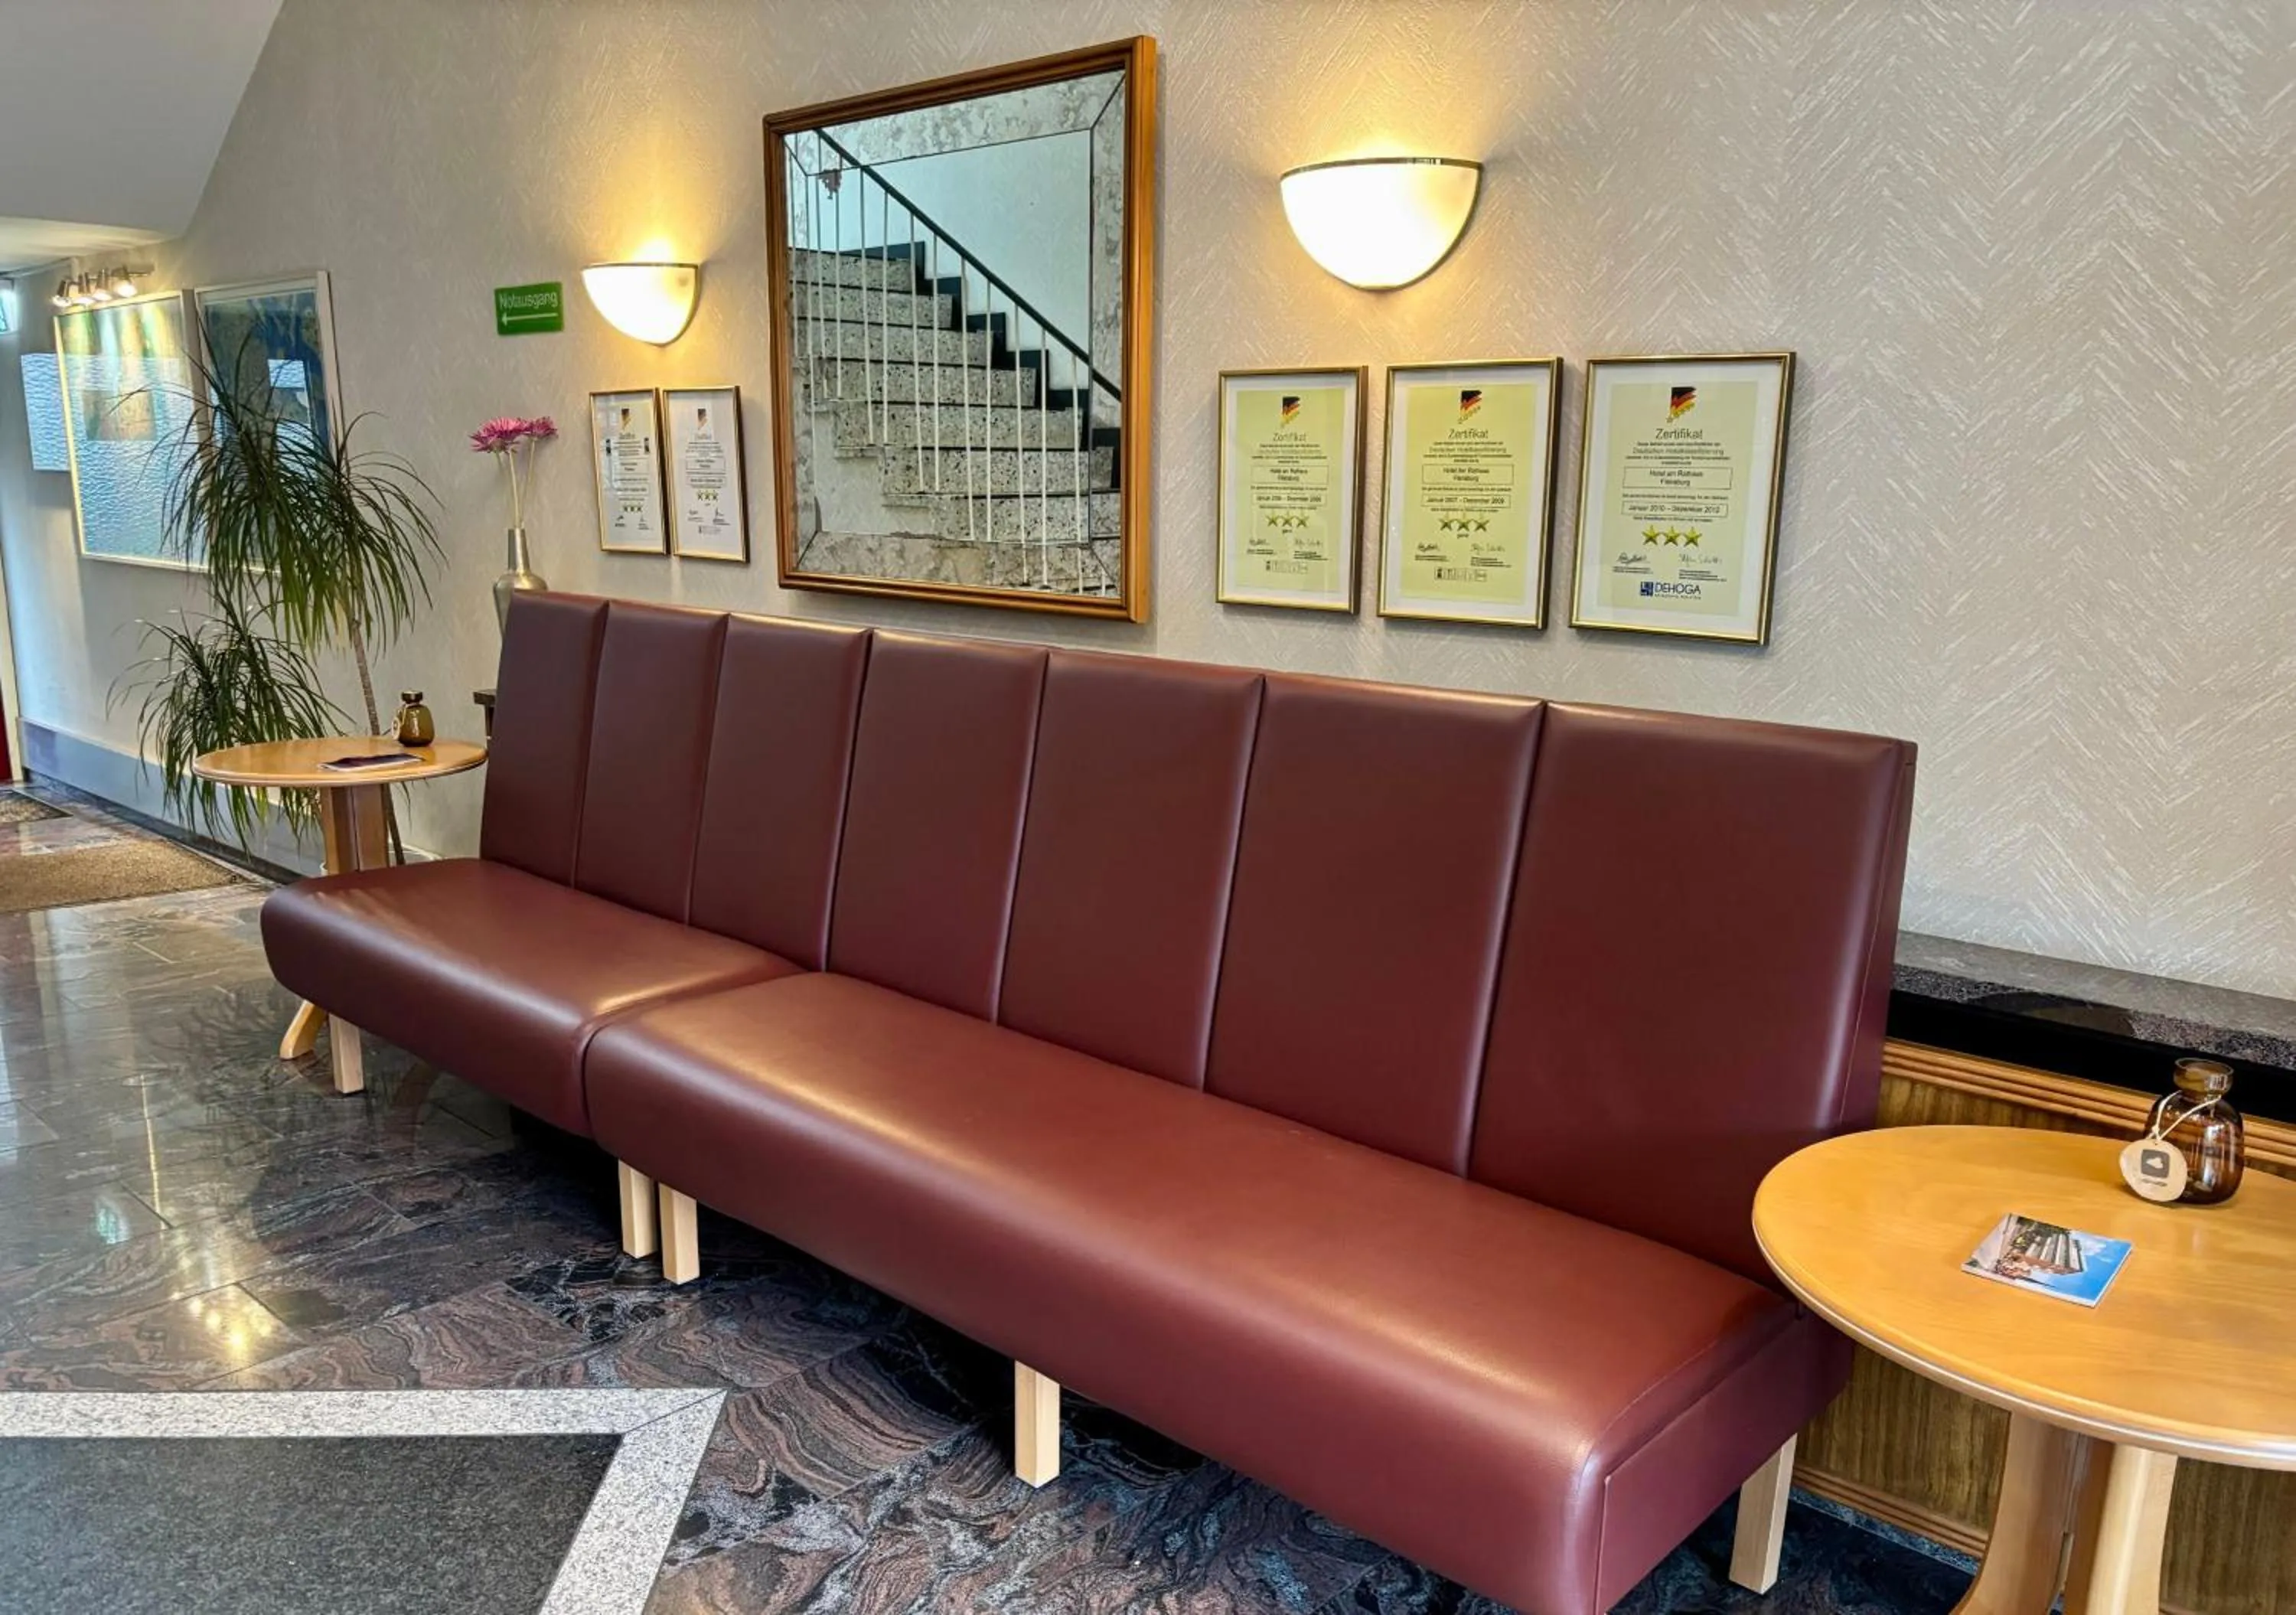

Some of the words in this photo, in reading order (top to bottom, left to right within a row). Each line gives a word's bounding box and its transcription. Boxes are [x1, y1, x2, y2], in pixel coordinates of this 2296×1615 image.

[499, 292, 558, 310] Notausgang
[1447, 429, 1489, 440] Zertifikat
[1655, 429, 1703, 440] Zertifikat
[1678, 469, 1704, 478] Rathaus
[1660, 478, 1691, 487] Flensburg
[1655, 582, 1701, 595] DEHOGA
